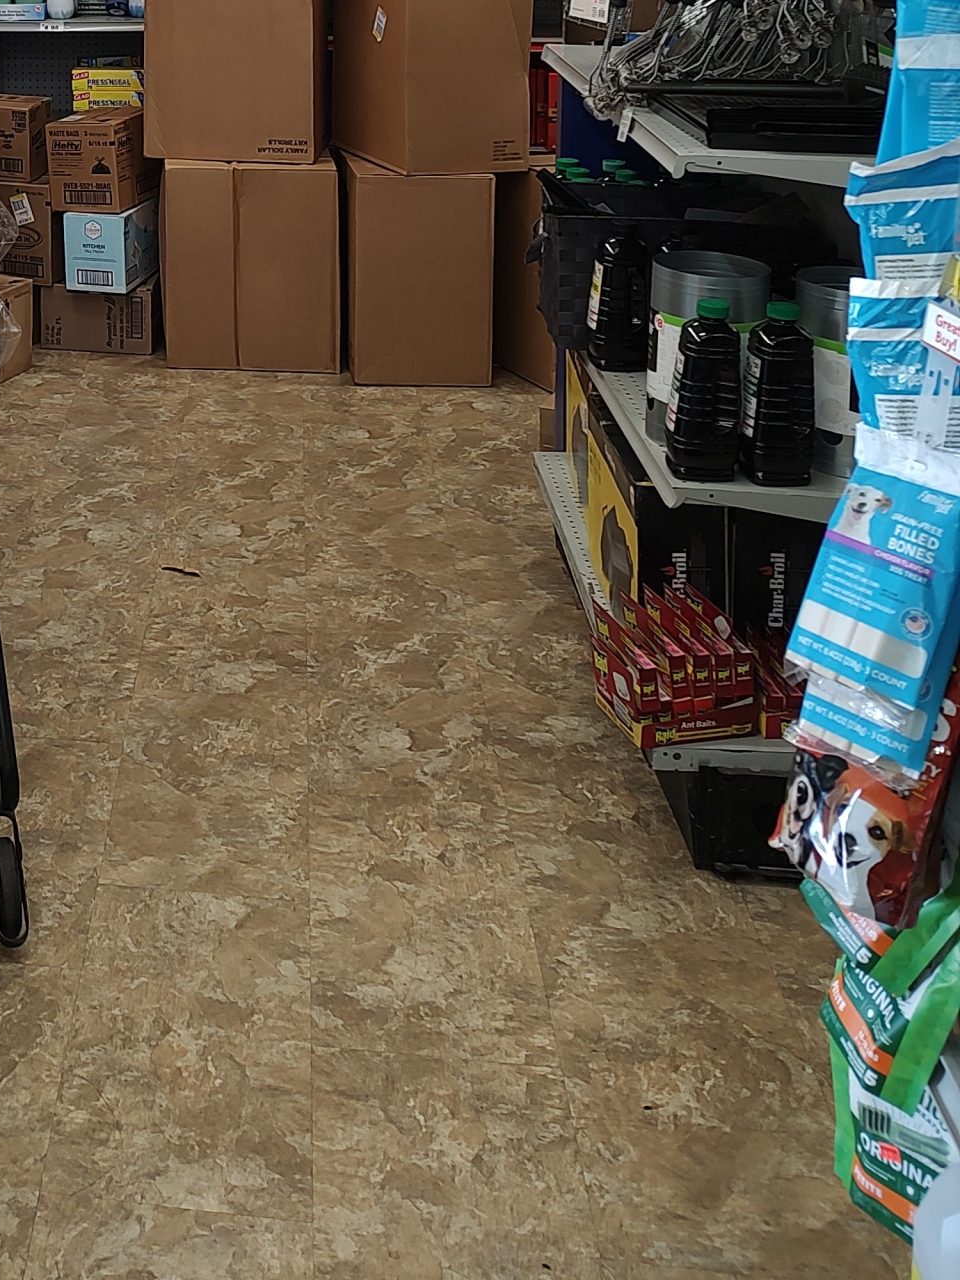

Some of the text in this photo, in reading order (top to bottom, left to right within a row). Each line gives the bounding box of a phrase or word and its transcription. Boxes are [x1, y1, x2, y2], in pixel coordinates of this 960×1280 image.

[53, 141, 80, 151] Hefty
[936, 331, 958, 352] Buy!
[894, 524, 940, 551] FILLED
[887, 537, 935, 564] BONES
[904, 570, 929, 585] TREAT
[767, 552, 786, 628] Char-Broil
[798, 635, 811, 647] NET
[871, 667, 908, 690] COUNT
[681, 720, 716, 729] Ant Baits
[656, 727, 677, 744] Raid
[875, 732, 909, 754] COUNT
[856, 946, 873, 965] 5
[863, 1069, 879, 1087] 5
